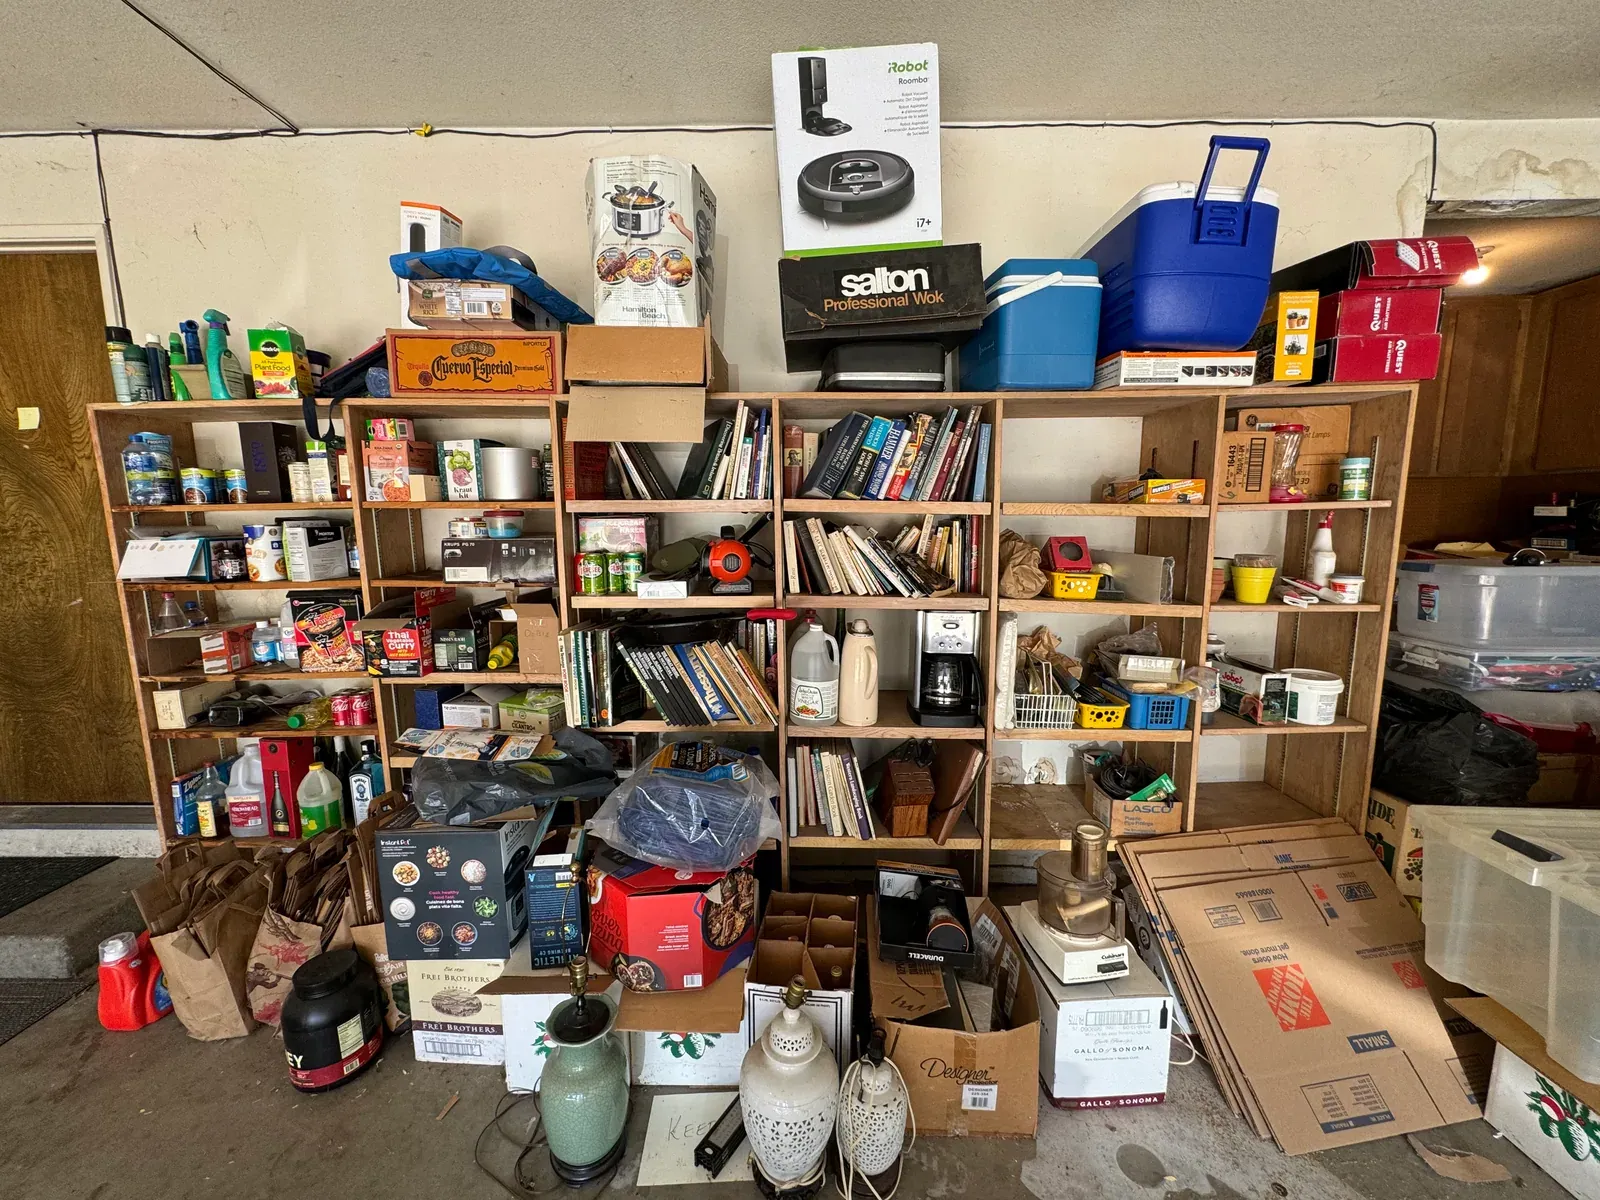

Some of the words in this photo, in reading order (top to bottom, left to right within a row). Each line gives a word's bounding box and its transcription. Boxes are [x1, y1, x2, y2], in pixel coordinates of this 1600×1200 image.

[888, 60, 928, 73] iRobot
[899, 76, 928, 85] Roomba
[916, 217, 931, 228] i7+
[1426, 240, 1442, 270] QUEST
[841, 266, 930, 297] salton
[622, 305, 656, 313] Hamilton
[824, 292, 909, 312] Professional
[914, 290, 945, 304] Wok
[1370, 296, 1382, 331] QUEST
[1395, 340, 1407, 374] QUEST
[431, 355, 471, 381] Cuervo
[468, 357, 513, 383] Especial
[718, 423, 731, 448] Discovering
[865, 426, 878, 446] GUSTAV
[870, 422, 886, 448] ECKSTEIN
[880, 428, 901, 460] HAMMER
[1311, 431, 1330, 439] Lamps
[852, 465, 861, 477] THE
[857, 451, 868, 466] BODY
[1227, 445, 1237, 468] 16443
[856, 471, 866, 482] HAS
[862, 452, 874, 468] HEAD
[388, 631, 410, 639] Thai
[388, 642, 415, 650] Curry
[688, 651, 720, 710] Thesauru
[1222, 672, 1244, 684] Jobe's
[183, 772, 203, 793] Ziploc
[1124, 804, 1172, 814] LASCO
[909, 952, 944, 962] DURACELL
[1240, 946, 1258, 957] done.
[1259, 944, 1276, 953] more
[1277, 942, 1290, 953] get
[1252, 954, 1271, 964] doers
[1272, 952, 1288, 963] How
[421, 973, 441, 981] FREI
[444, 974, 491, 983] BROTHERS
[1267, 966, 1284, 1008] DEPOT
[1279, 964, 1305, 1031] HOME
[422, 1022, 443, 1030] FREI
[1353, 1032, 1391, 1051] SMALL
[920, 1057, 992, 1085] Designer
[1119, 1096, 1158, 1105] SONOMA
